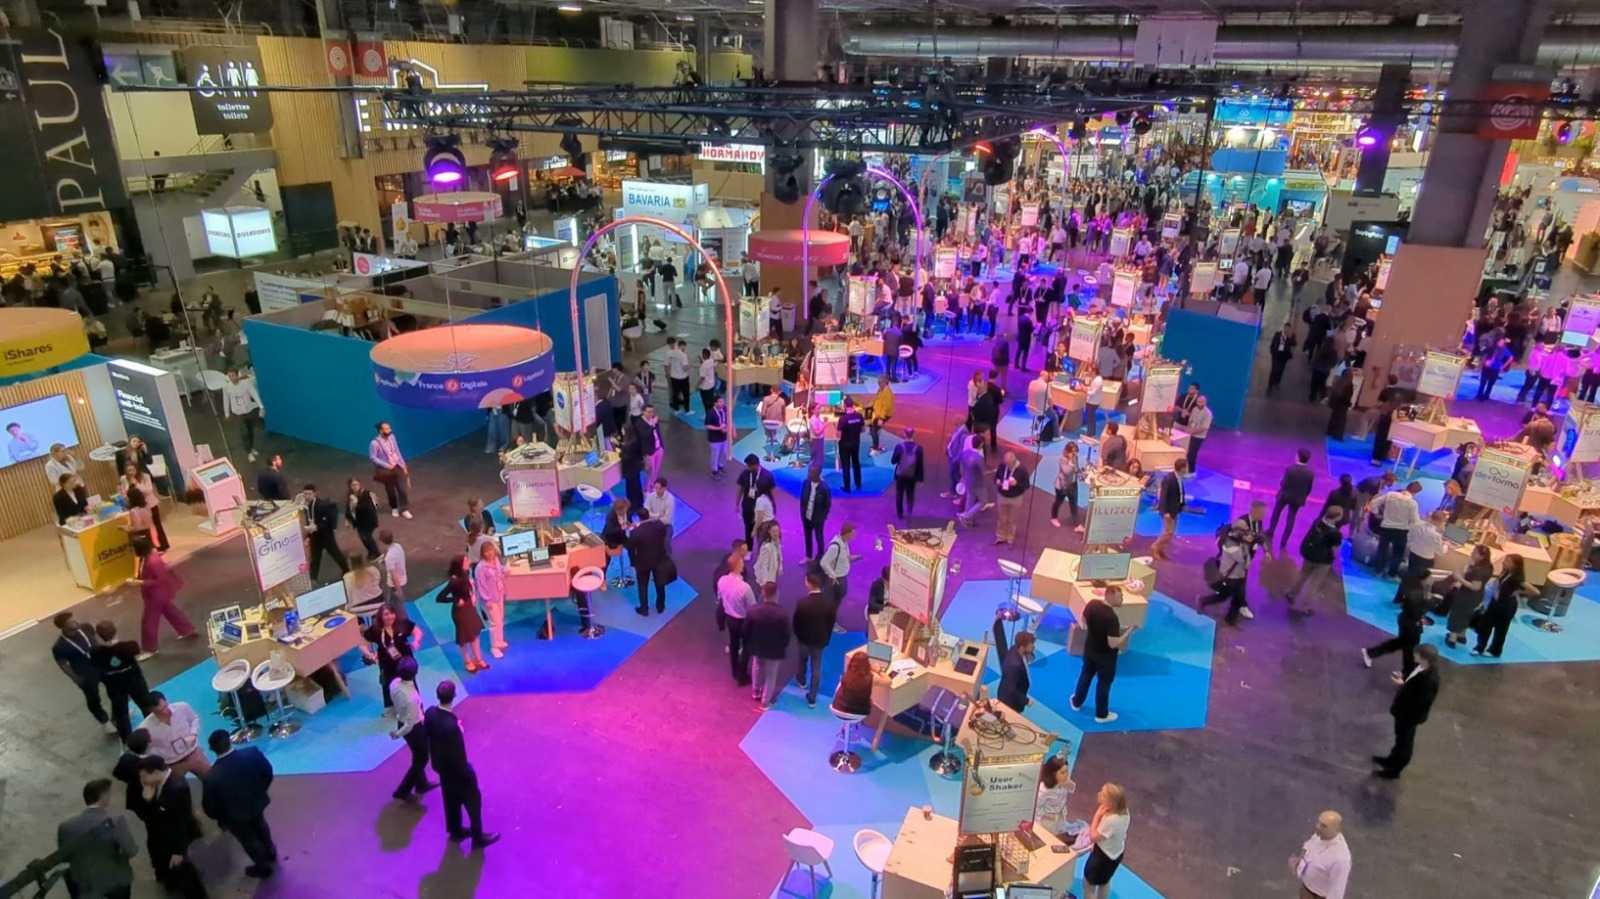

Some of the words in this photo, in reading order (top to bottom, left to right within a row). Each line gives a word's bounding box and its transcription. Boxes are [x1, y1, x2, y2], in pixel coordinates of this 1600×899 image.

[217, 103, 250, 111] toilettes
[223, 111, 248, 120] toilets
[22, 28, 104, 213] PAUL
[628, 193, 671, 207] BAVARIA
[4, 343, 53, 361] iShares
[418, 381, 444, 389] France
[460, 381, 488, 390] Digitale
[988, 783, 1024, 791] Shaker
